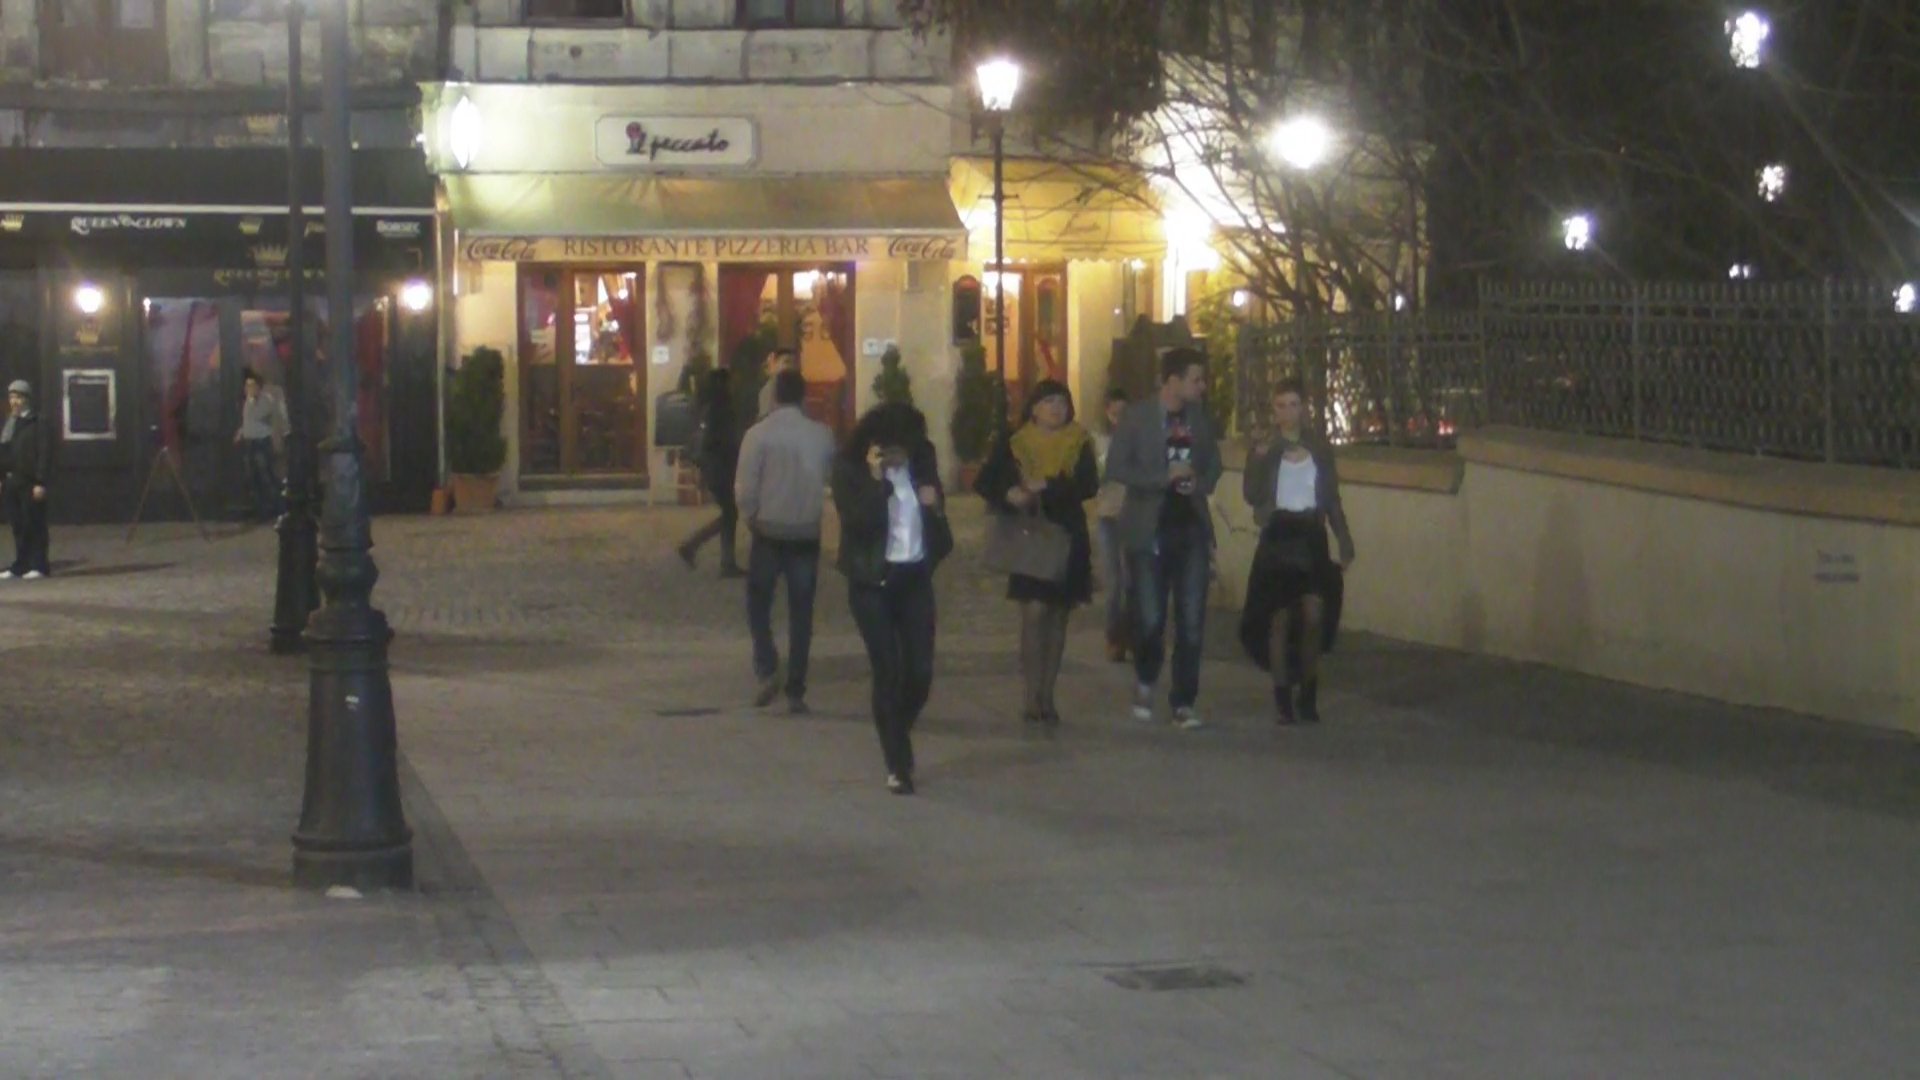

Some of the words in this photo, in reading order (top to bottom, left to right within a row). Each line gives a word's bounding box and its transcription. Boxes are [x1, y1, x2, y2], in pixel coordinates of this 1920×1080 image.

[651, 128, 729, 160] peccato
[563, 237, 708, 256] RISTORANTE
[715, 237, 817, 256] PIZZERIA
[825, 238, 869, 255] BAR
